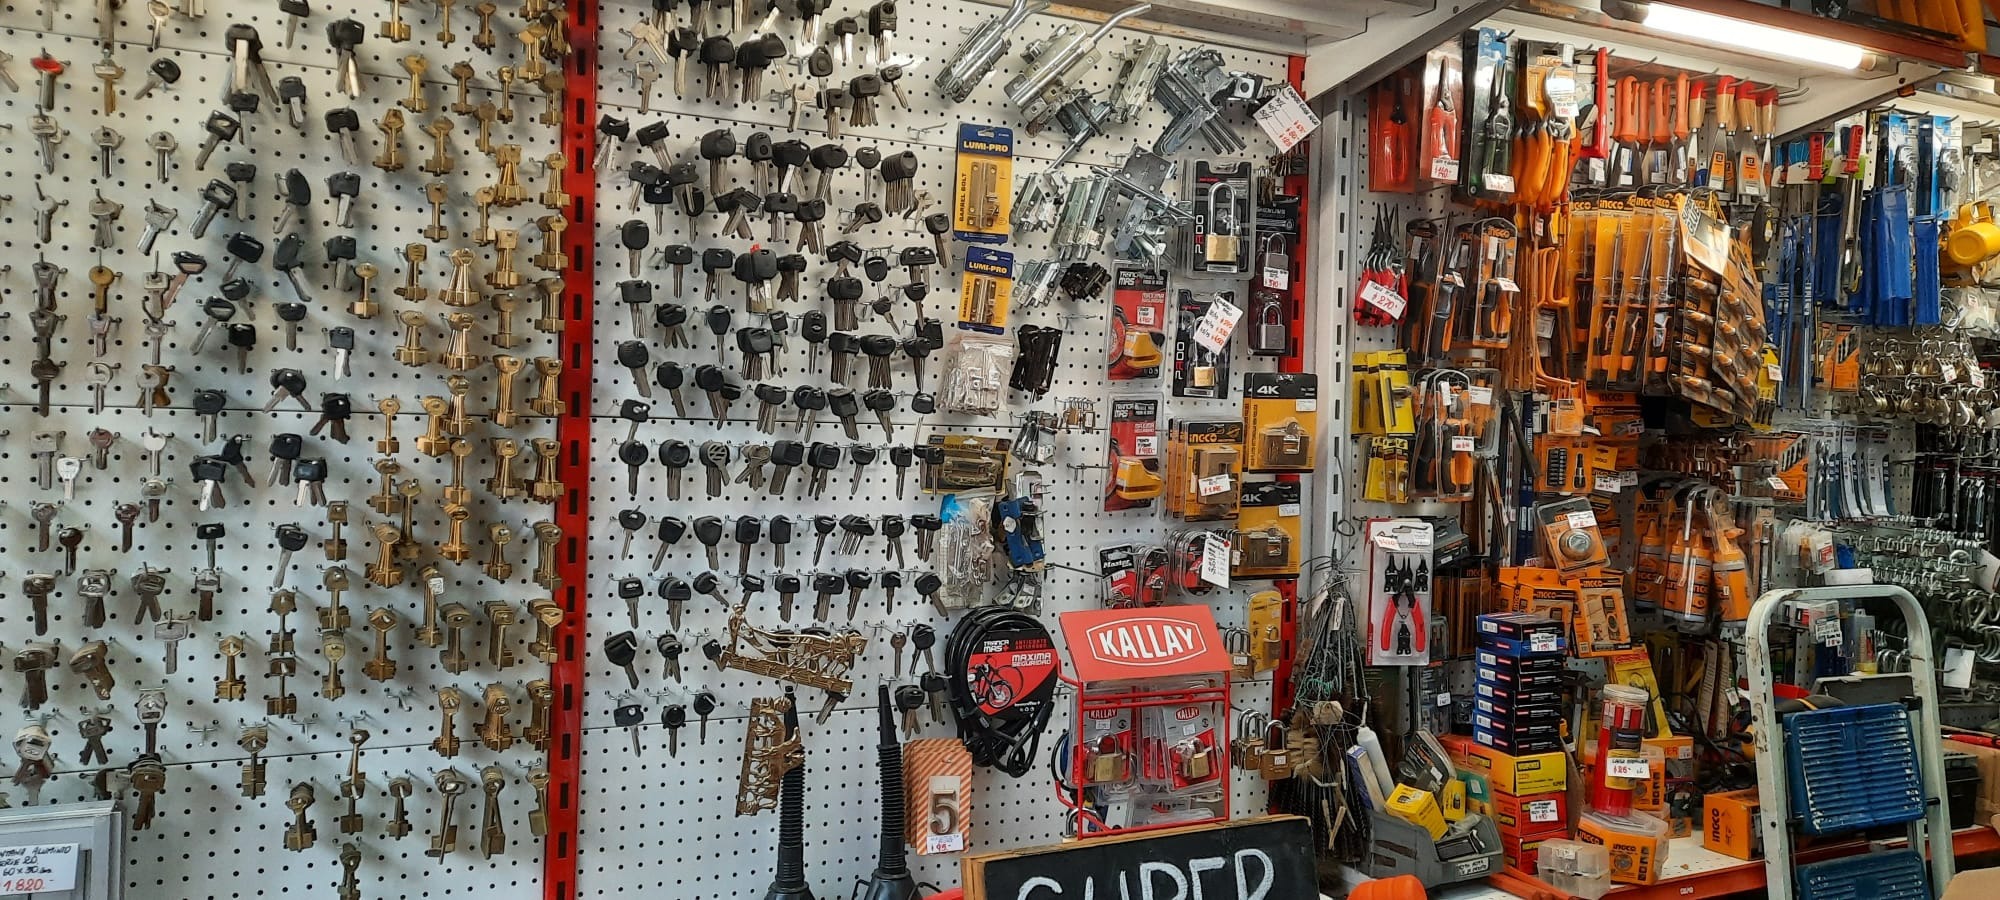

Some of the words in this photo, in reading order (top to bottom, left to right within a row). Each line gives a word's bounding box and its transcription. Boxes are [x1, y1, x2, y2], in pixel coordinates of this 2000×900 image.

[963, 141, 1009, 152] LUMI-PRO
[968, 261, 1008, 273] LUMI-PRO
[1257, 385, 1280, 395] 4K
[1189, 434, 1217, 443] INGCO
[1241, 493, 1262, 503] 4K
[1103, 560, 1130, 569] Master
[1099, 624, 1195, 659] KALLAY
[1012, 653, 1052, 663] MAXIMA
[1090, 708, 1117, 719] KALLAY
[1177, 707, 1200, 719] KALLAY
[930, 789, 957, 835] 5
[1712, 807, 1720, 842] INGCO
[1614, 843, 1636, 852] INGCO
[1017, 849, 1274, 900] PER
